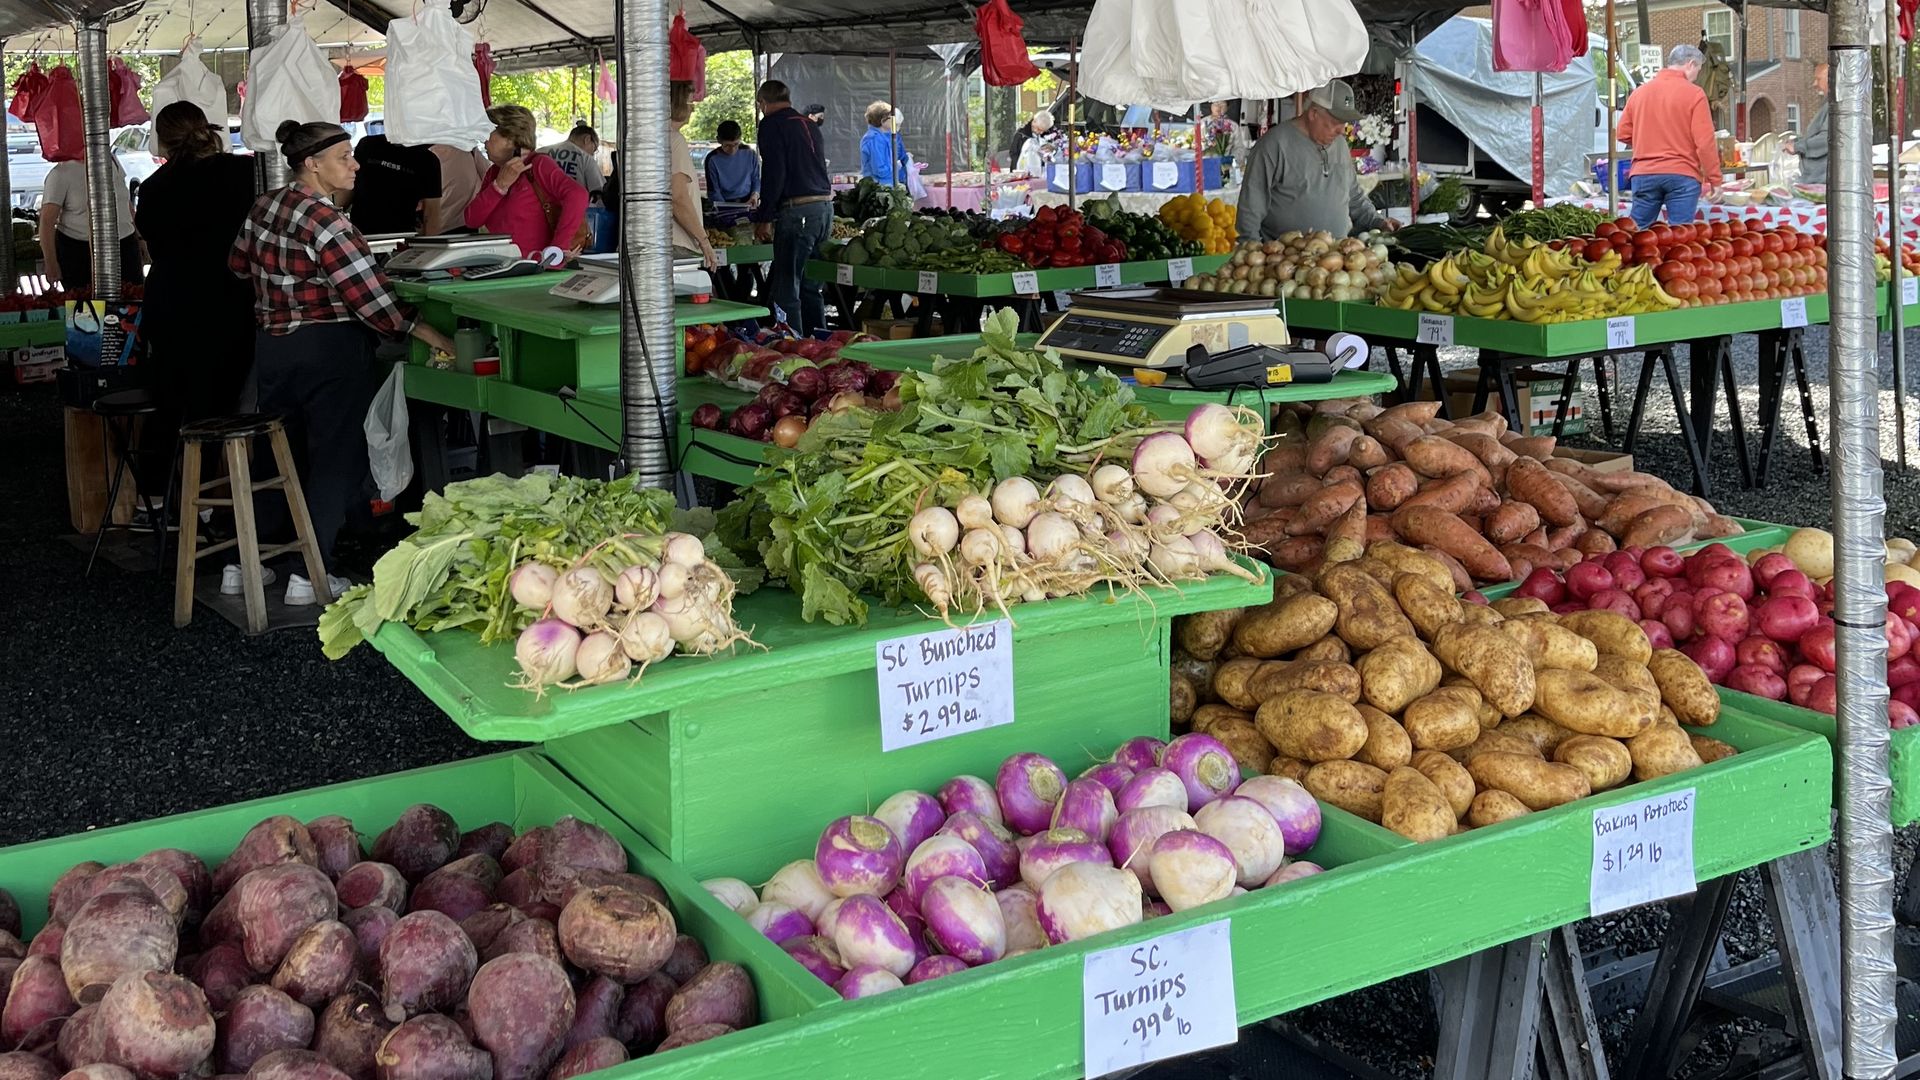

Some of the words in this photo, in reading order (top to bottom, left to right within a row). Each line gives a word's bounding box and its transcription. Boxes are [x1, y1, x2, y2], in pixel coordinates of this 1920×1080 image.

[547, 148, 581, 162] NOT
[882, 643, 908, 672] SC
[919, 625, 996, 665] Bunched
[897, 666, 981, 706] Turnips
[1594, 813, 1638, 837] Baking
[1644, 792, 1693, 823] Potatoes
[1602, 842, 1643, 872] $1.29
[1649, 842, 1662, 863] lb
[1094, 973, 1187, 1016] Turnips
[1177, 1016, 1192, 1035] lb
